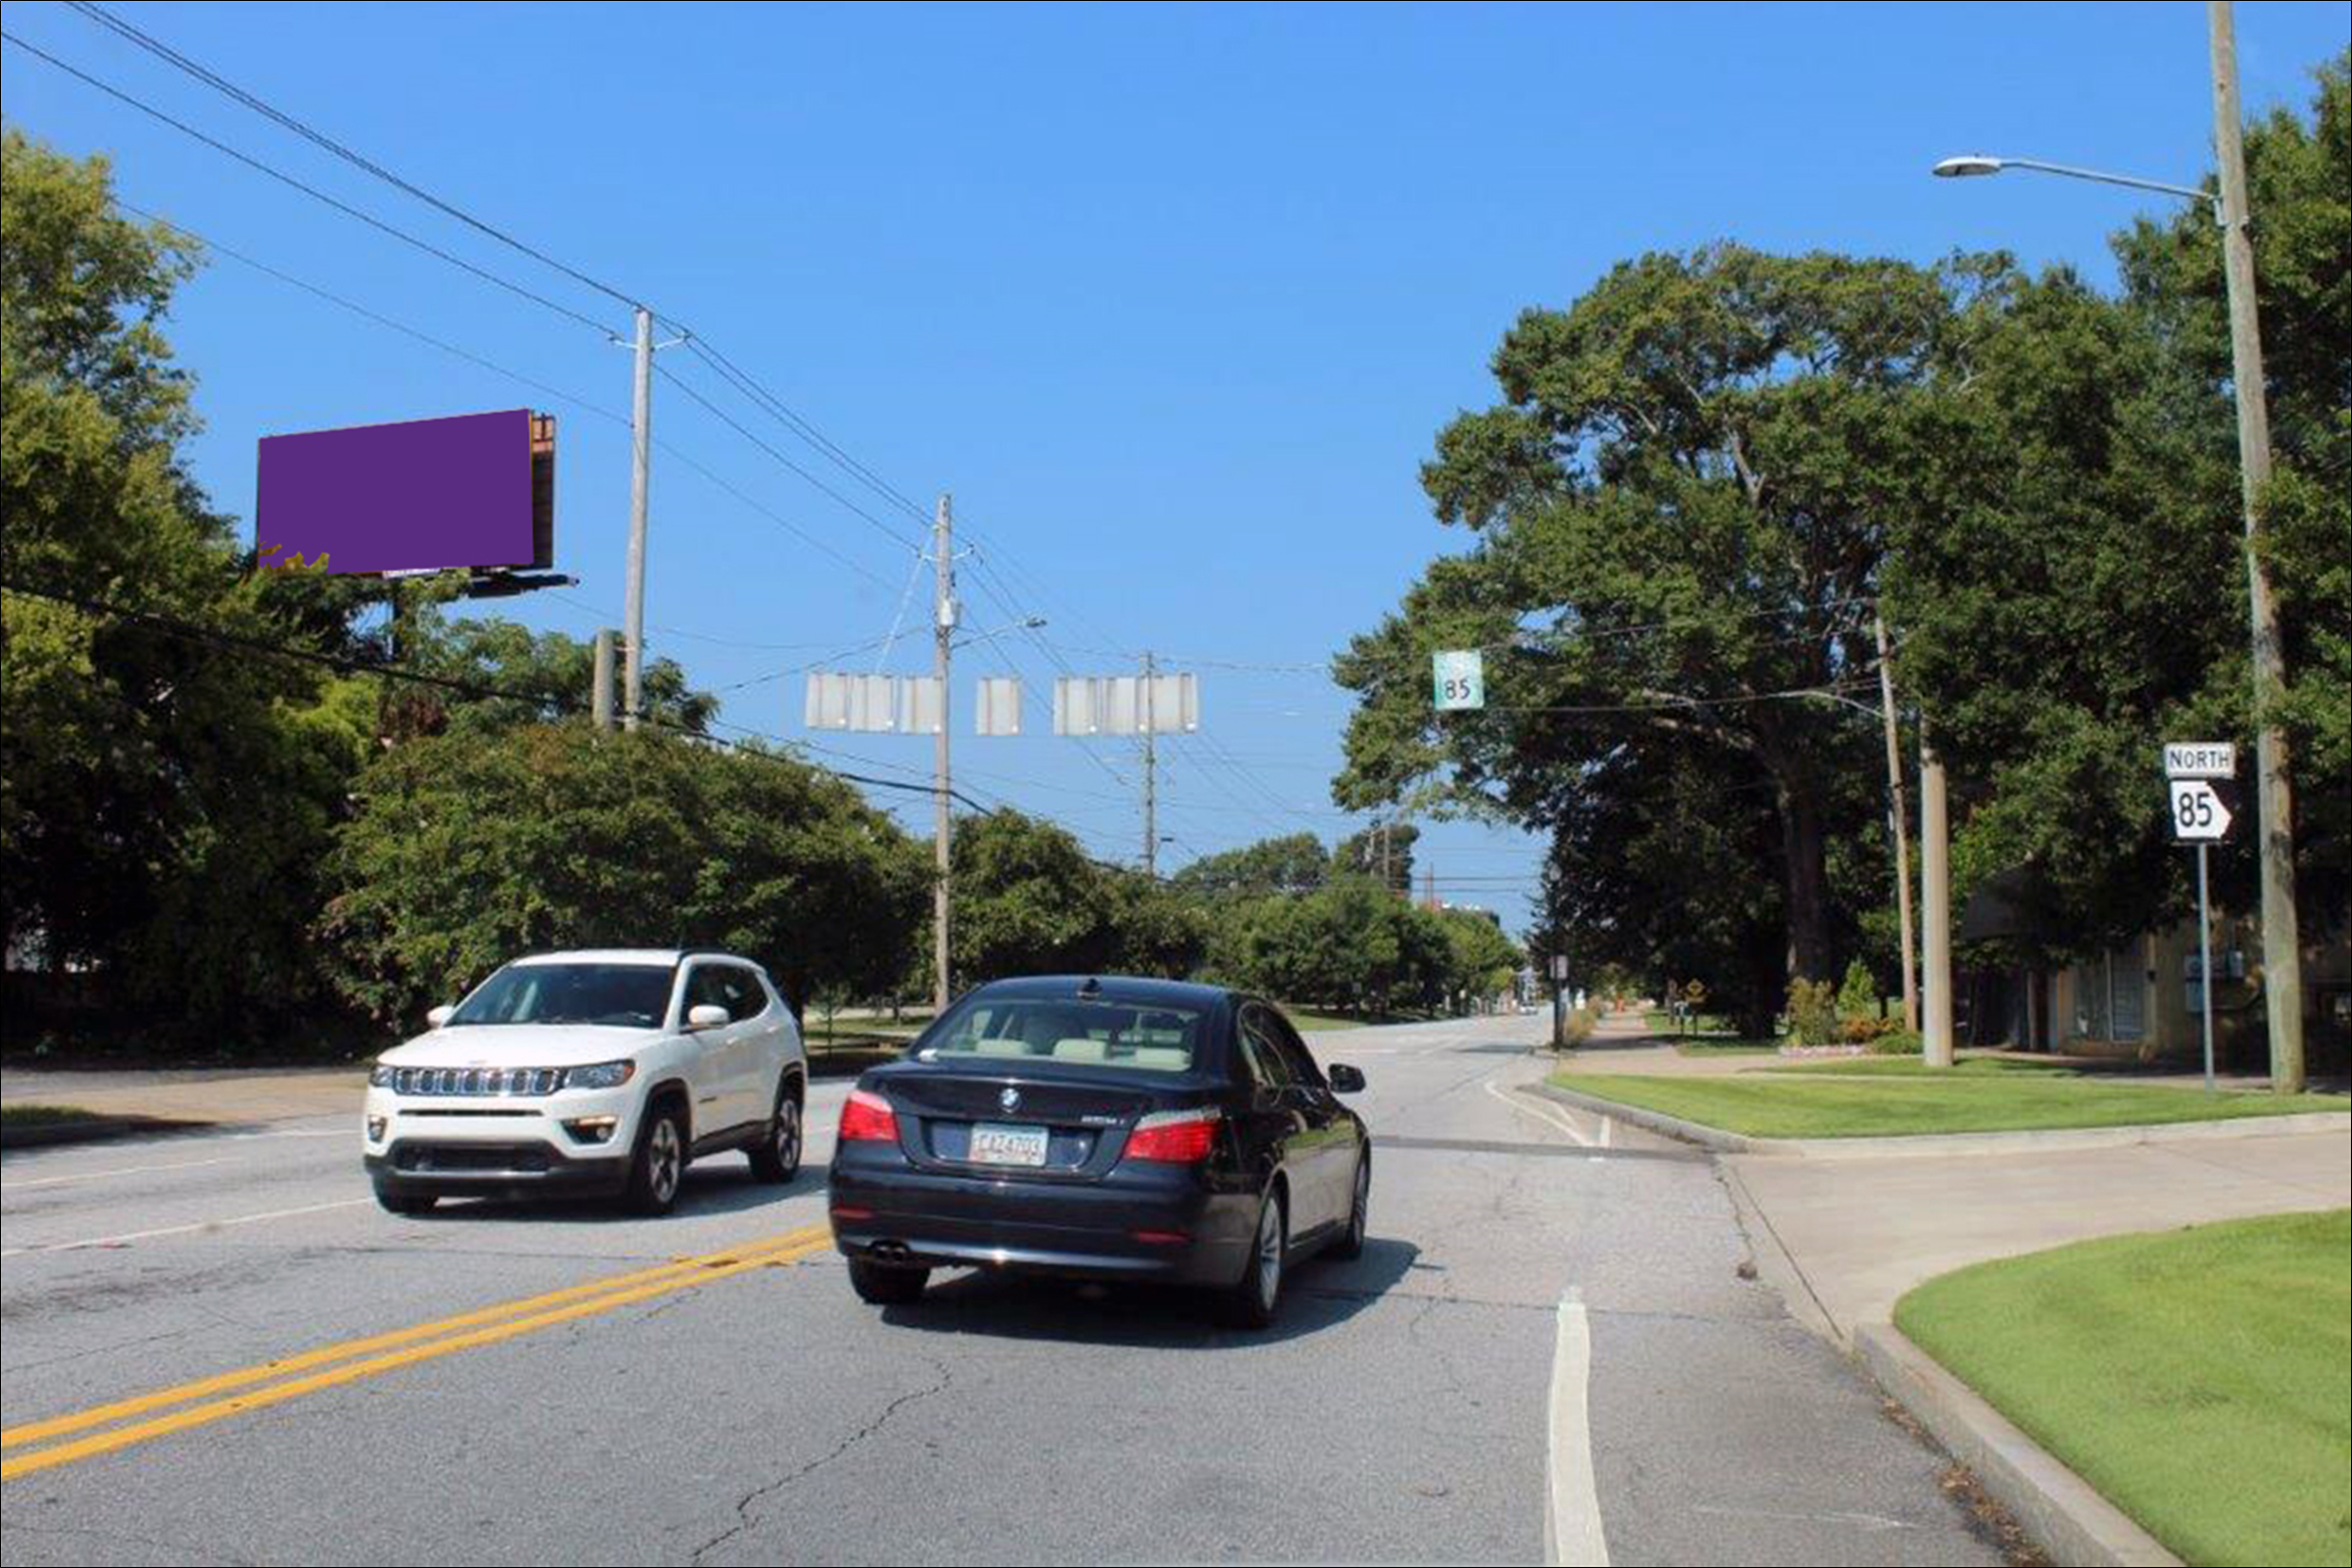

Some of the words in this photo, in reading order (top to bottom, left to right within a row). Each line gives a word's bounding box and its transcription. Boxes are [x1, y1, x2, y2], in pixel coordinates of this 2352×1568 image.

[1445, 678, 1471, 700] 85
[2169, 750, 2230, 768] NORTH
[2179, 792, 2213, 828] 85
